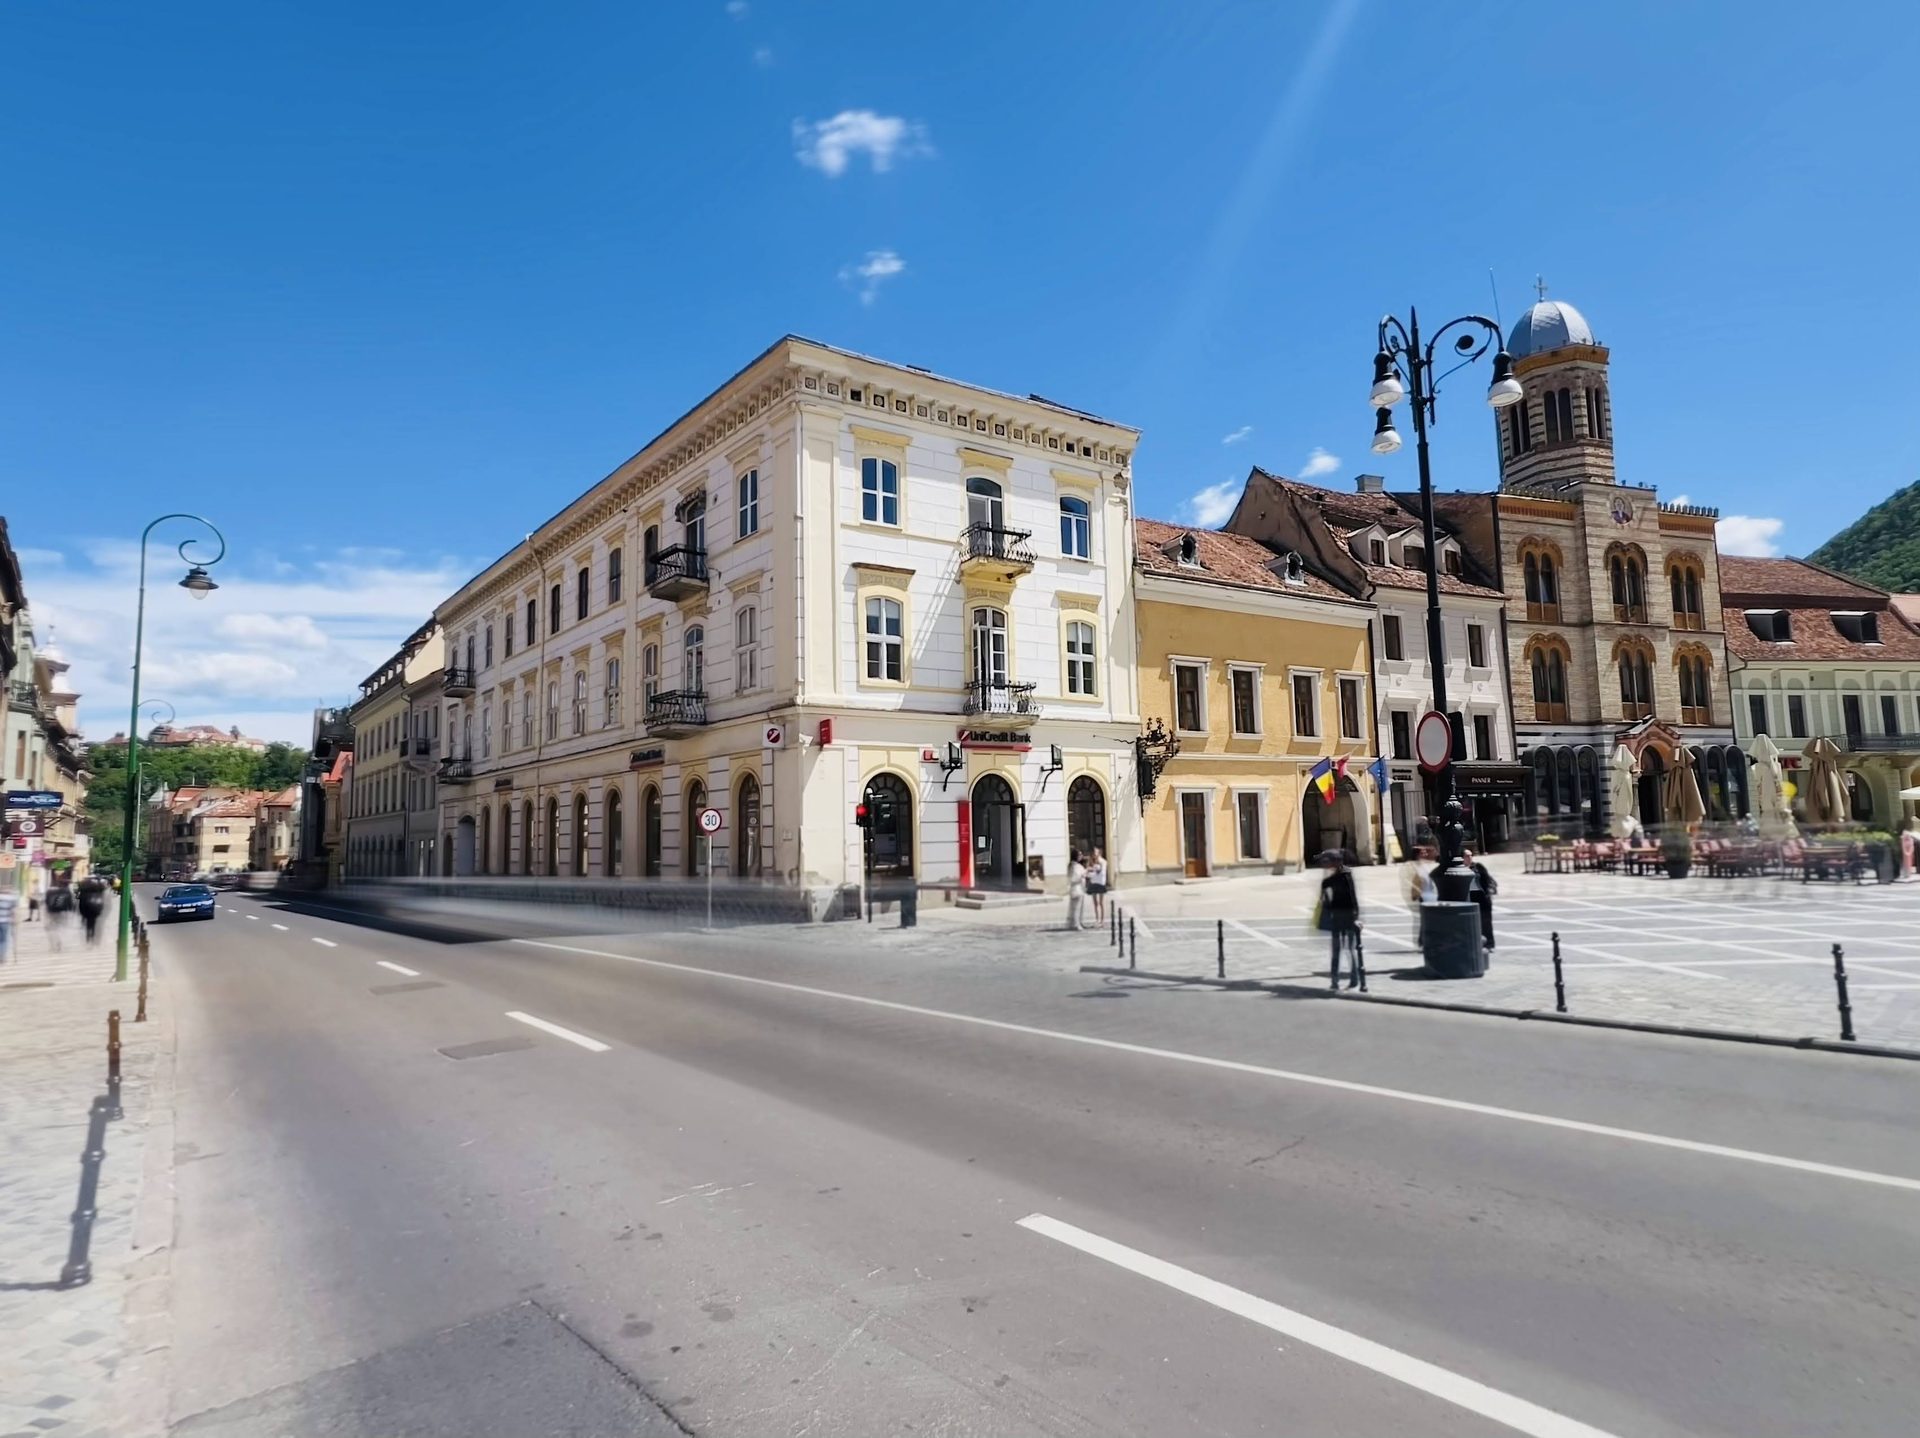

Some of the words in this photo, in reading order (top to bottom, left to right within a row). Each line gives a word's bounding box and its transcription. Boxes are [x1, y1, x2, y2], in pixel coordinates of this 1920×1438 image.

[970, 731, 1008, 742] UniCredit
[1010, 731, 1032, 743] Bank
[704, 814, 717, 827] 30
